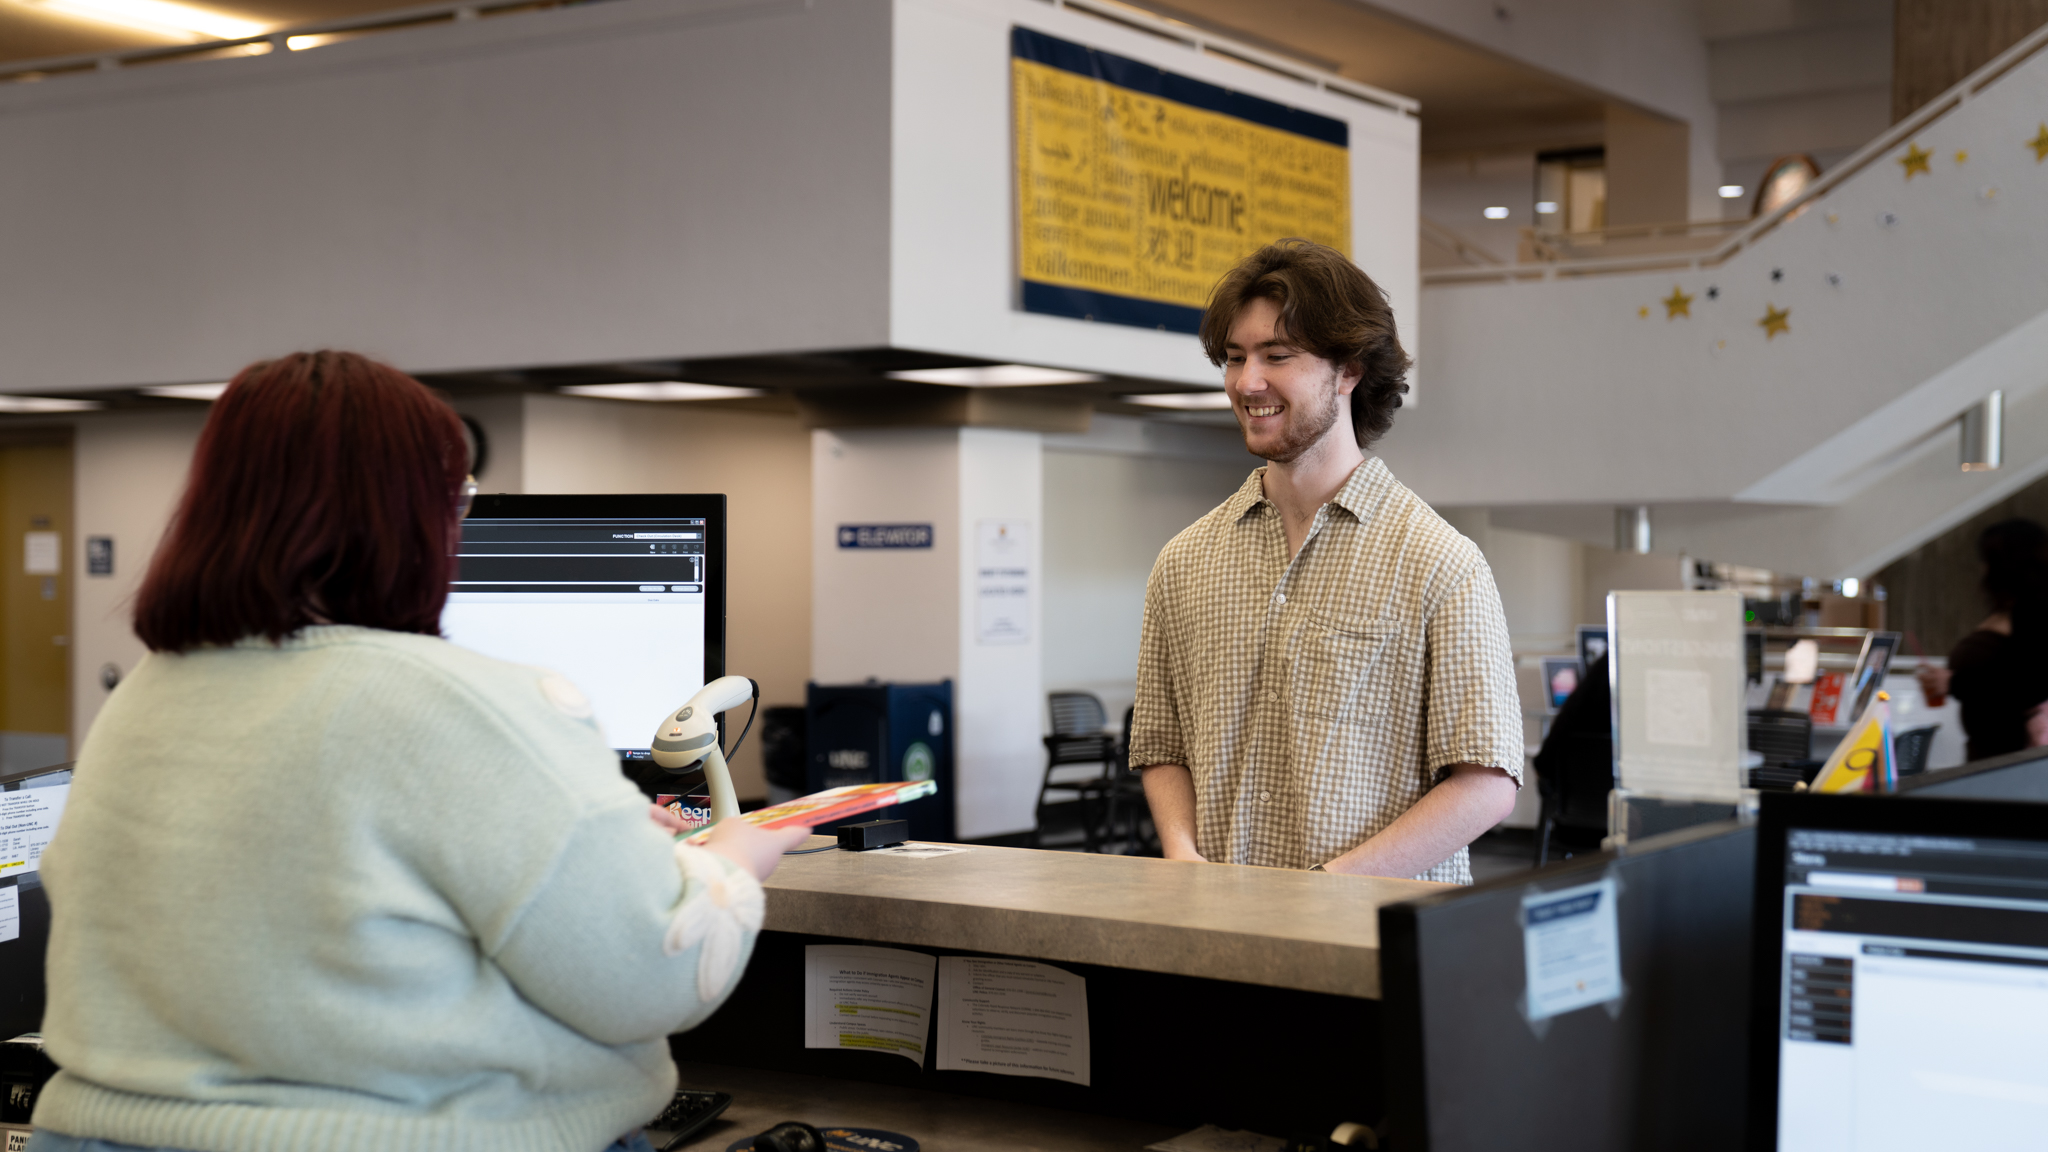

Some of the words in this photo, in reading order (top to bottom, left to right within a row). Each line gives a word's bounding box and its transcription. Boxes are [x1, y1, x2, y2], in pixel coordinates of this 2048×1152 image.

[1147, 163, 1244, 234] welcome
[857, 527, 928, 546] ELEVATOR
[670, 802, 710, 824] Keep
